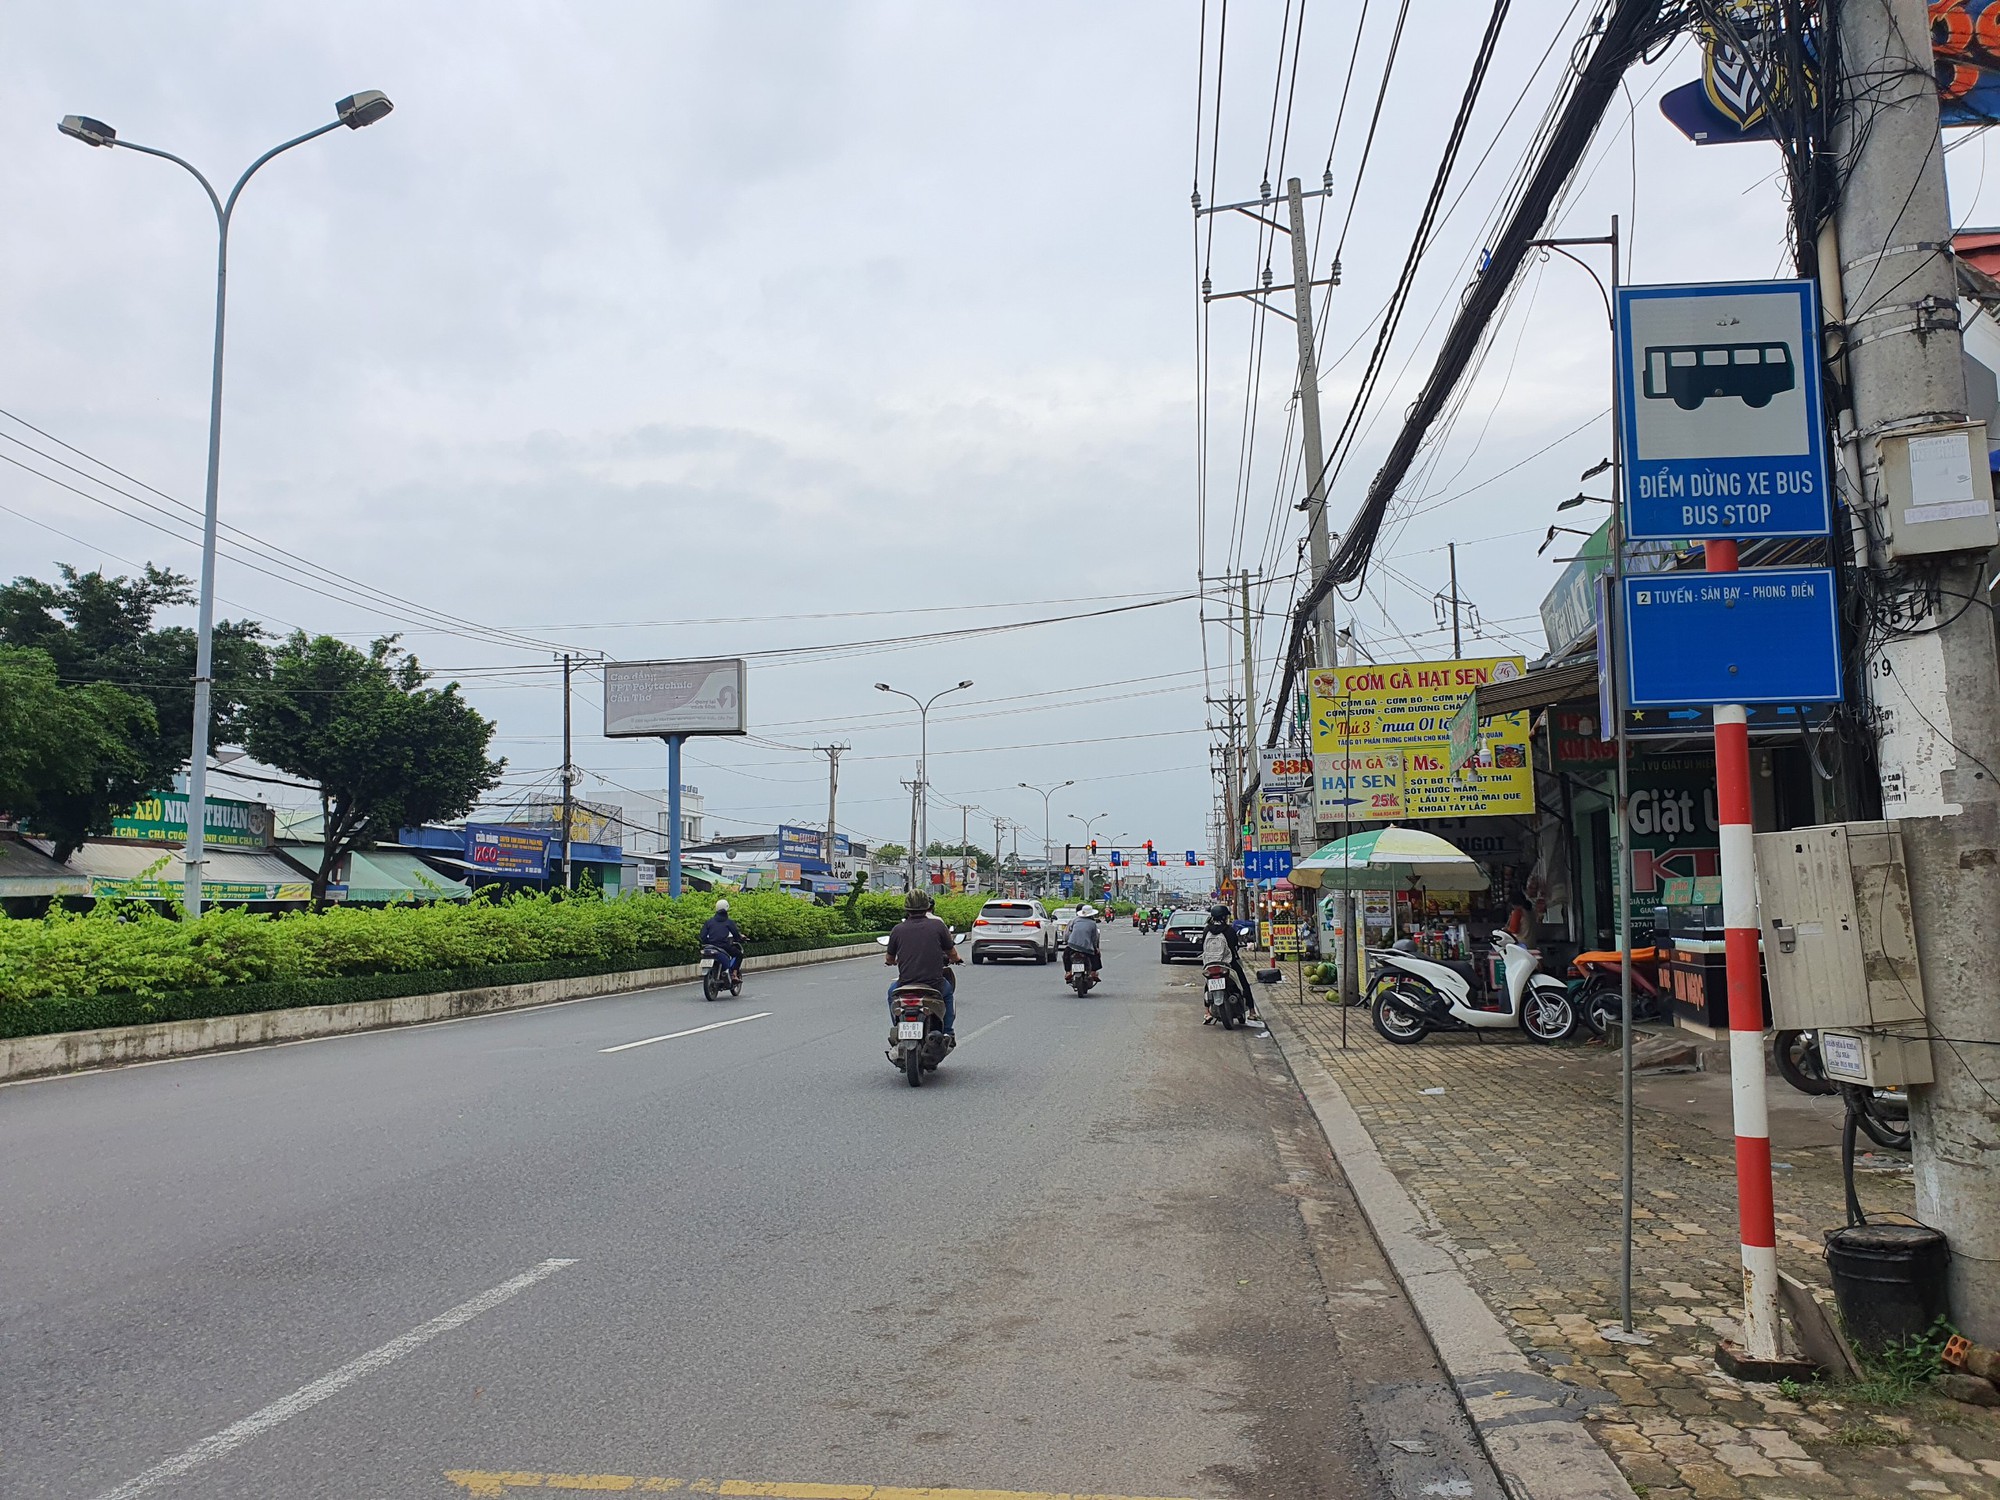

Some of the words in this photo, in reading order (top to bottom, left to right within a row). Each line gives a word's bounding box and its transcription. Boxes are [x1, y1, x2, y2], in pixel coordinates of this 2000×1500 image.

[1639, 466, 1684, 499] ĐIỂM
[1691, 468, 1741, 497] DỪNG
[1747, 472, 1770, 495] XE
[1777, 470, 1814, 494] BUS
[1682, 505, 1719, 526] BUS
[1724, 503, 1771, 525] STOP
[1640, 593, 1648, 603] 2
[1655, 587, 1698, 604] TUYẾN:
[1701, 586, 1720, 600] SÂN
[1723, 586, 1741, 600] BAY
[1753, 584, 1786, 599] PHONG
[1791, 581, 1814, 597] ĐIỀN
[610, 673, 630, 681] Cao
[1345, 672, 1386, 692] CƠM
[1390, 668, 1415, 689] GÀ
[1418, 669, 1451, 691] HẠT
[1455, 668, 1488, 685] SEN
[610, 683, 631, 692] FPT
[632, 681, 693, 692] Polytechnic
[610, 694, 630, 703] Cần
[631, 693, 652, 702] Thơ
[1341, 699, 1362, 707] CƠM
[1386, 697, 1407, 705] CƠM
[1432, 694, 1454, 702] CƠM
[1326, 709, 1347, 717] CƠM
[1384, 706, 1405, 714] CƠM
[1362, 720, 1370, 733] 3
[1382, 721, 1414, 733] mua
[1423, 734, 1436, 742] CHO
[1366, 756, 1384, 769] GÀ
[1413, 755, 1444, 771] Ms.
[1322, 776, 1356, 793] HẠT
[1362, 774, 1397, 788] SEN
[1371, 793, 1400, 807] 25k
[1440, 795, 1450, 803] LY
[1503, 792, 1522, 800] QUE
[1418, 805, 1446, 813] KHOAI
[1629, 788, 1696, 842] Giặt
[205, 801, 249, 834] THUẬN
[218, 835, 237, 844] CANH
